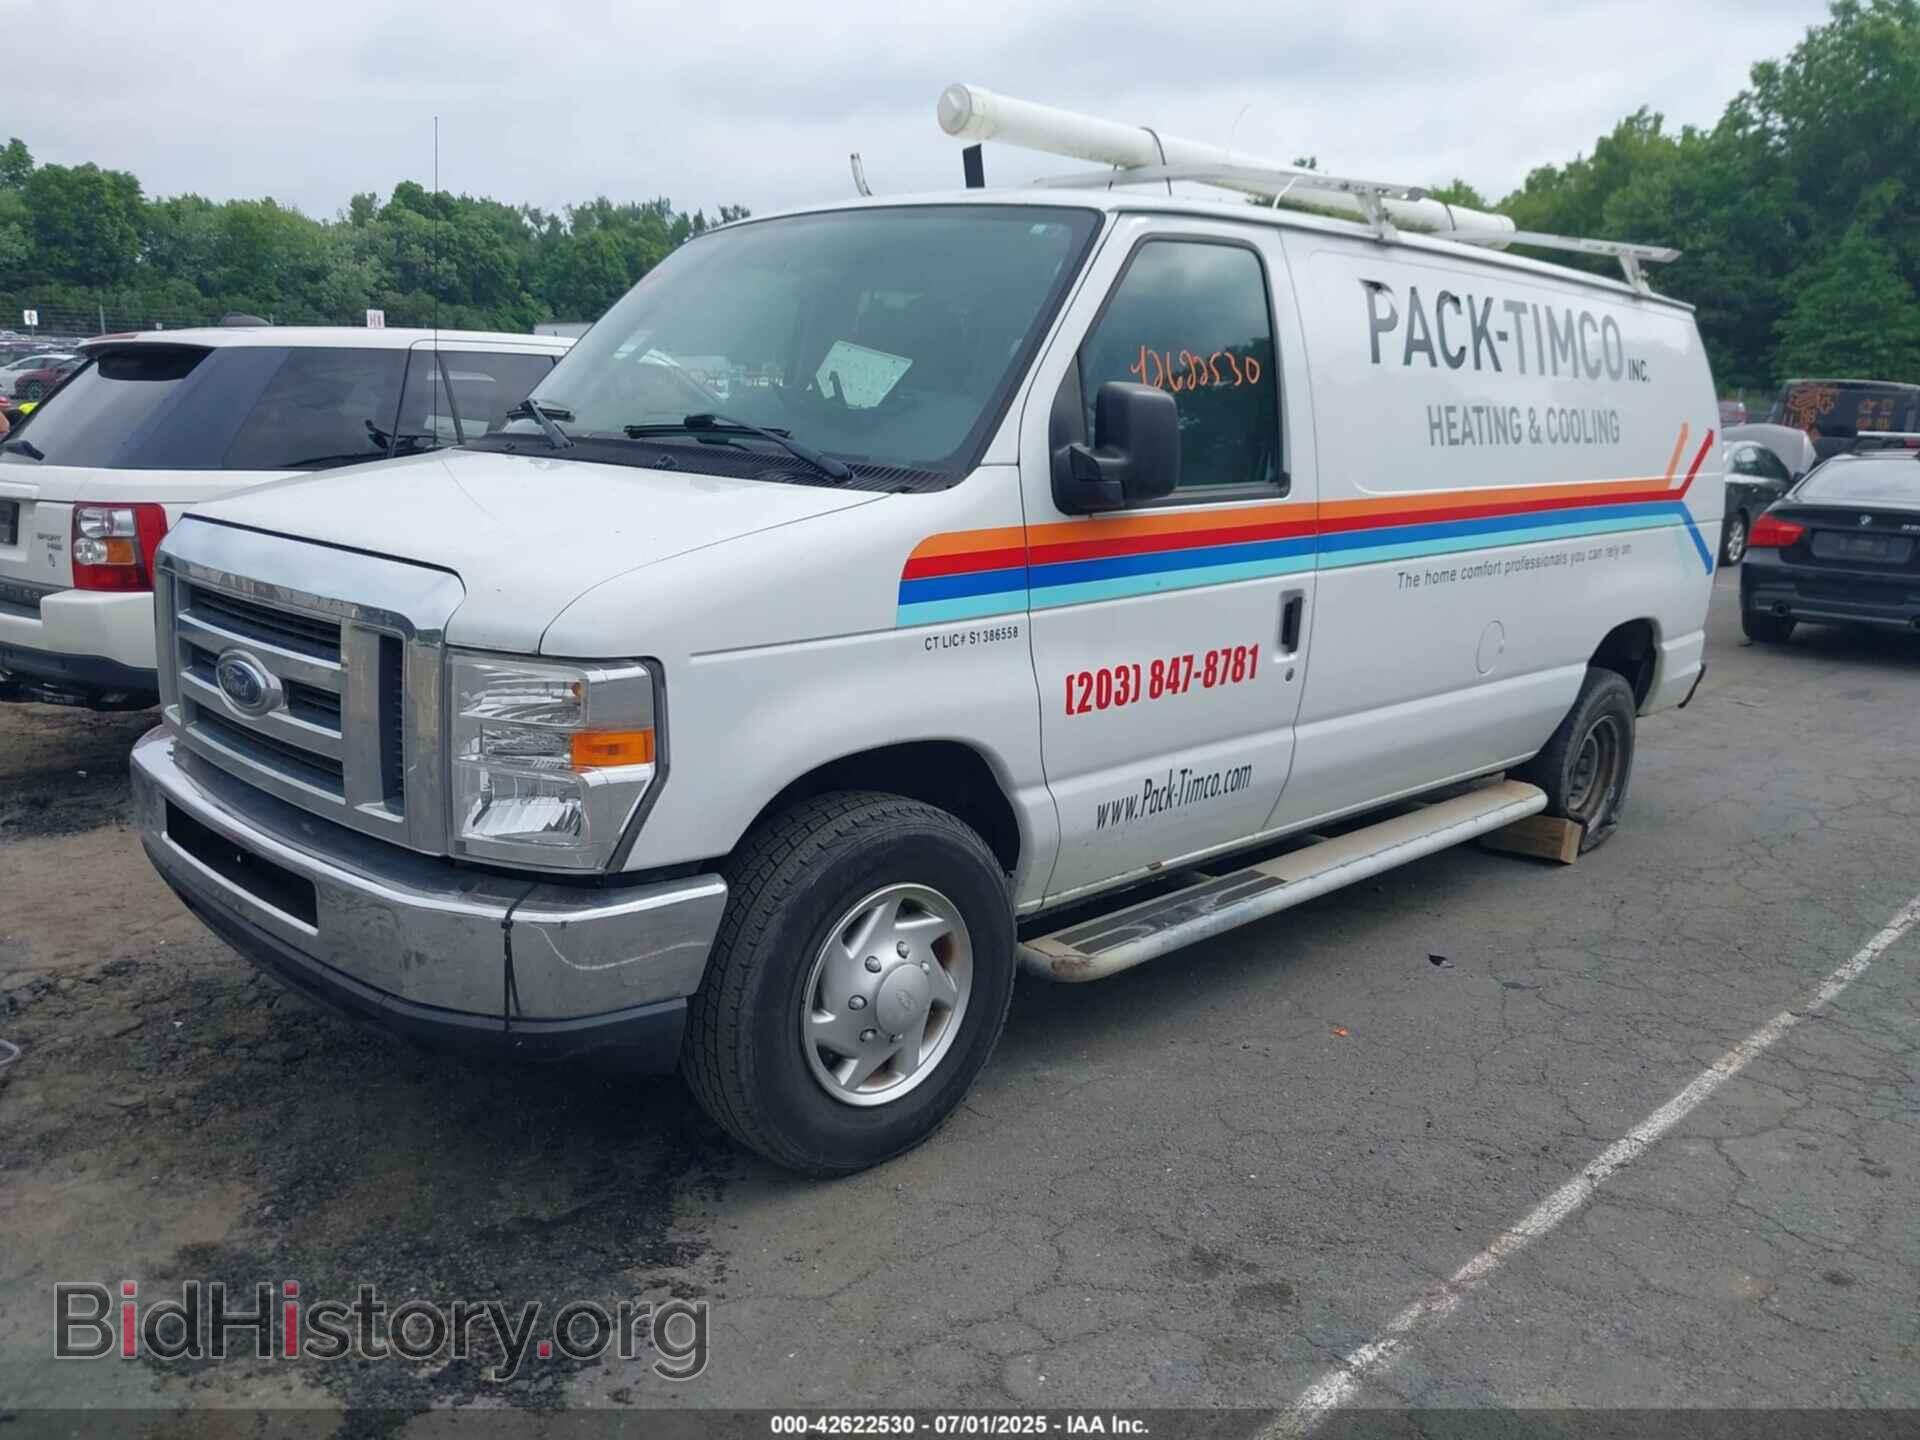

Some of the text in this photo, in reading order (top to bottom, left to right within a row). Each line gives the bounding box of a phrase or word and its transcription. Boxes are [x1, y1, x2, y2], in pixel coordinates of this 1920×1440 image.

[1359, 278, 1624, 381] PACK-TIMCO
[1628, 359, 1651, 382] INC.
[1427, 405, 1620, 447] HEATING & COOLING
[1397, 571, 1420, 589] The
[1424, 567, 1457, 585] home
[1460, 560, 1502, 580] comfort
[1504, 551, 1568, 575] professionals
[1570, 551, 1586, 568] you
[1588, 548, 1602, 561] can
[925, 625, 1019, 651] CT LIC# S1386558
[1064, 643, 1260, 716] (203) 847-8781
[1095, 762, 1253, 830] www.Pack-Timco.com
